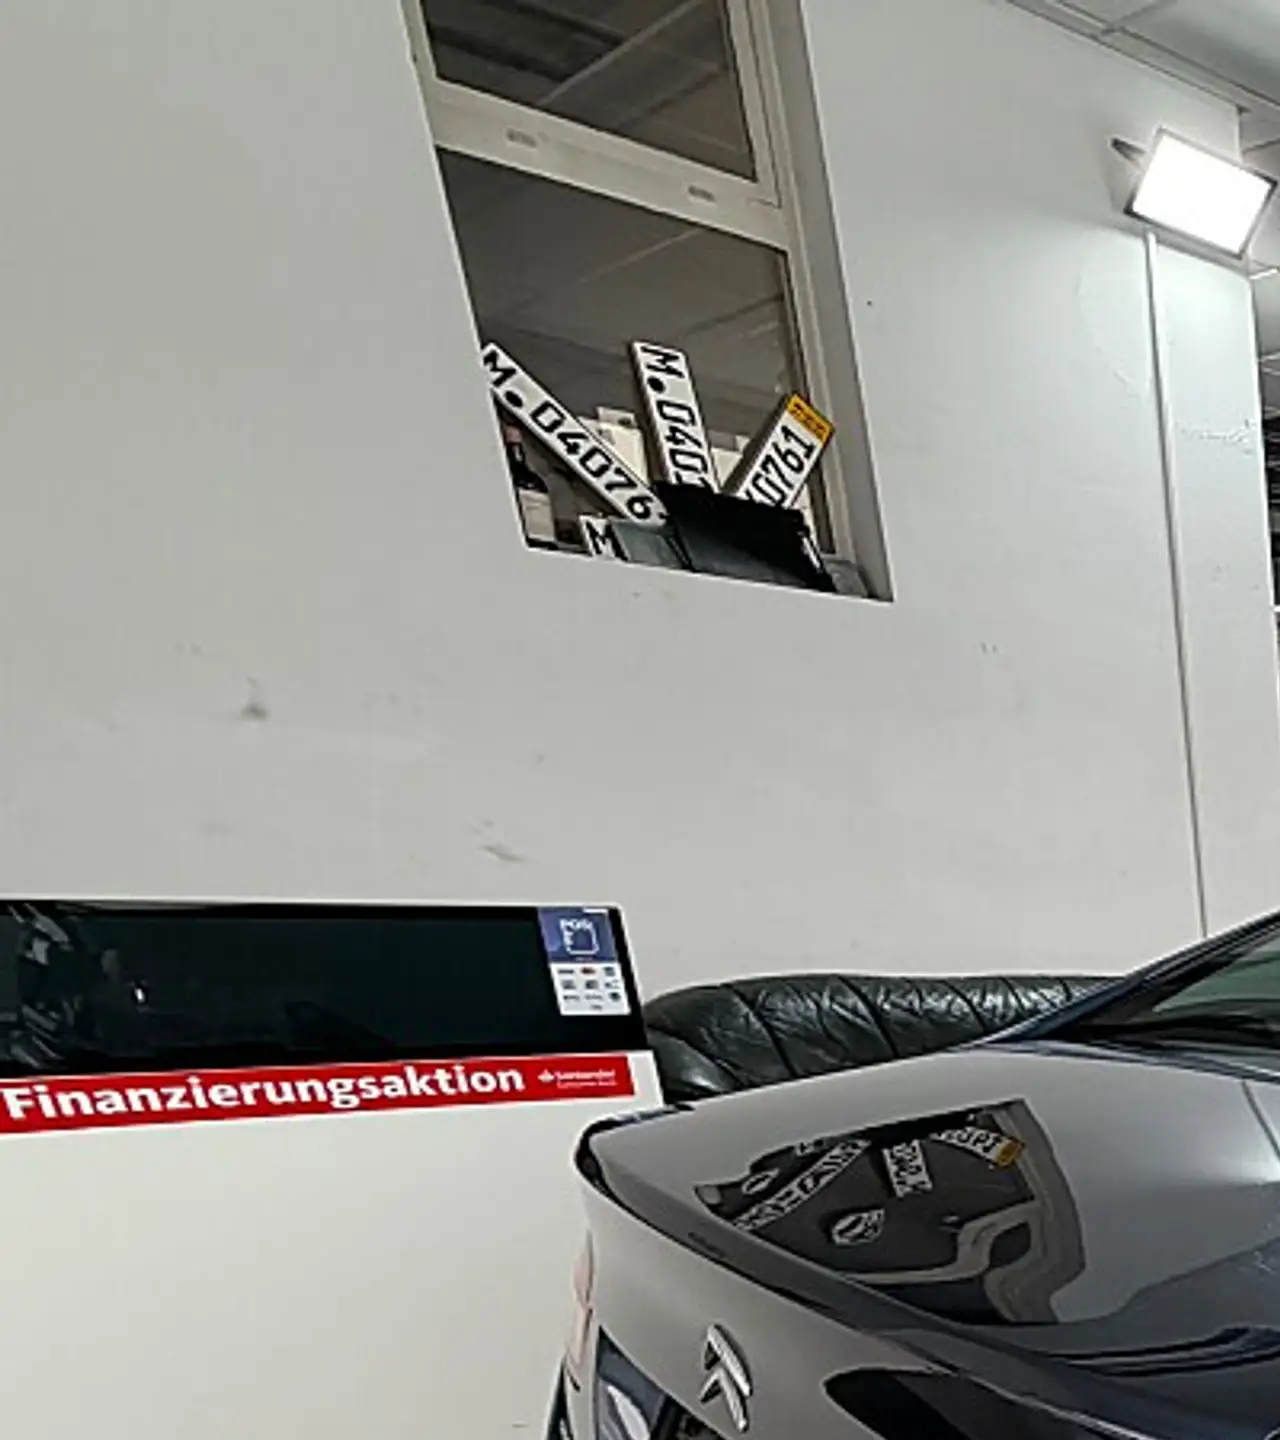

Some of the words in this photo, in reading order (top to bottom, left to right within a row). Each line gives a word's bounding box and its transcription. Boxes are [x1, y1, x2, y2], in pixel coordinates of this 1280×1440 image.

[529, 401, 670, 524] 04076
[744, 424, 815, 507] 0761
[2, 1064, 525, 1120] Finanzierungsaktion
